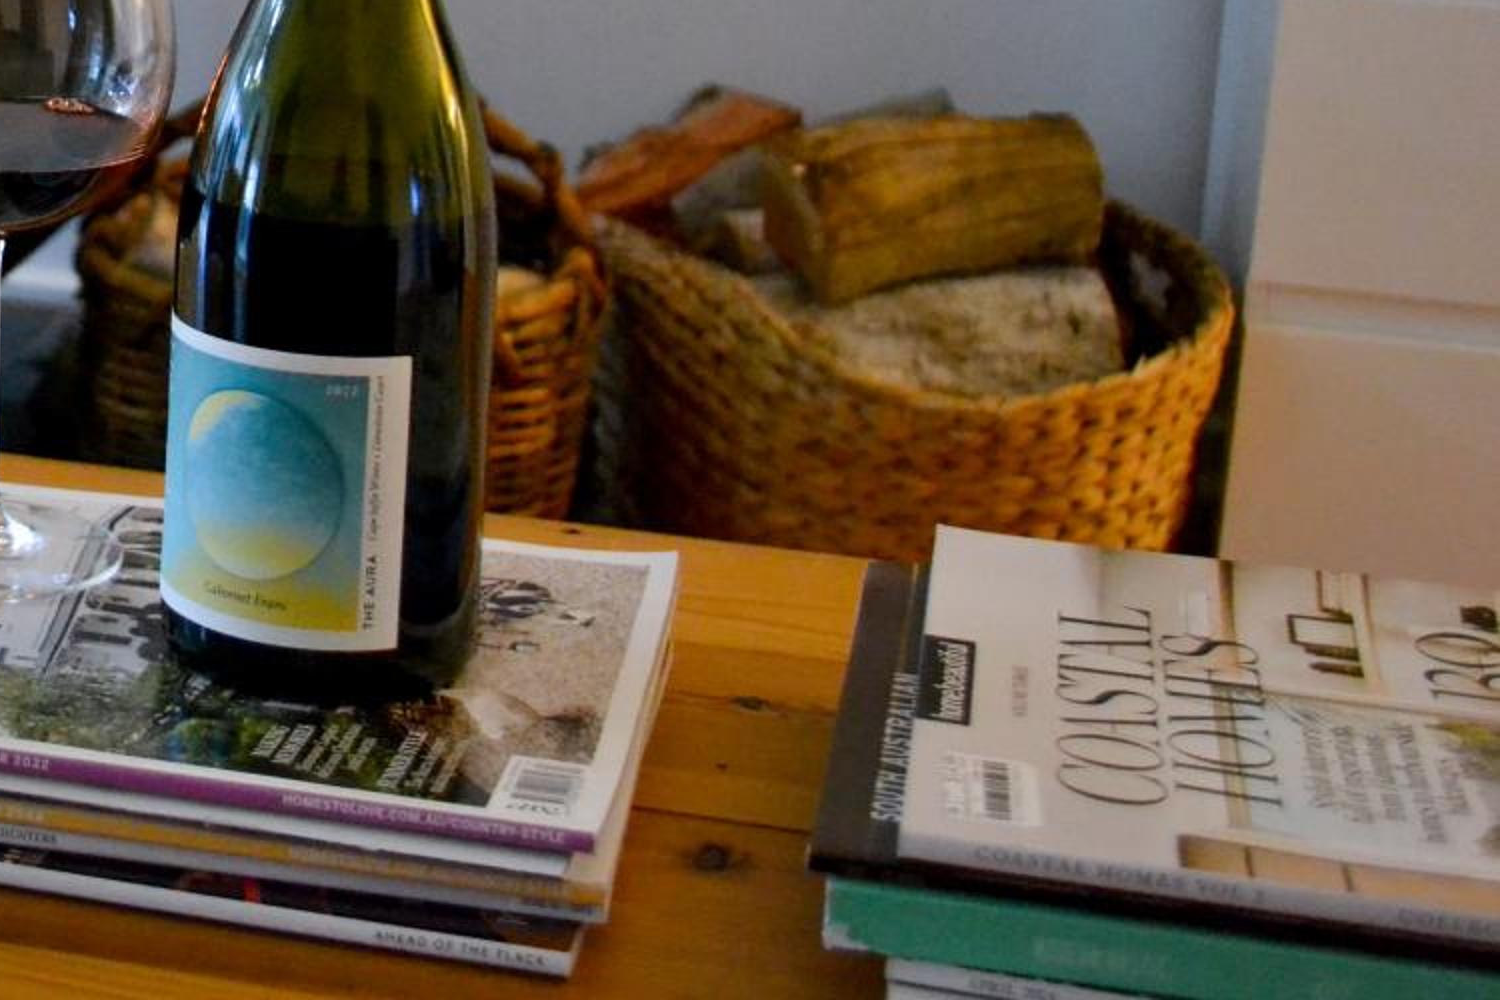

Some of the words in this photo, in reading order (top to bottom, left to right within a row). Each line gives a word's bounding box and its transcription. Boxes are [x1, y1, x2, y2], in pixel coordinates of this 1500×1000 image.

[365, 555, 378, 597] AURA
[362, 603, 375, 630] THE
[880, 672, 920, 768] AUSTRALIAN
[1055, 605, 1168, 806] COASTAL
[1159, 632, 1283, 808] HOMES
[870, 769, 906, 822] SOUTH
[972, 845, 1091, 877] COASTAL
[375, 930, 428, 947] AHEAD
[432, 937, 451, 950] OF
[460, 943, 489, 958] THE
